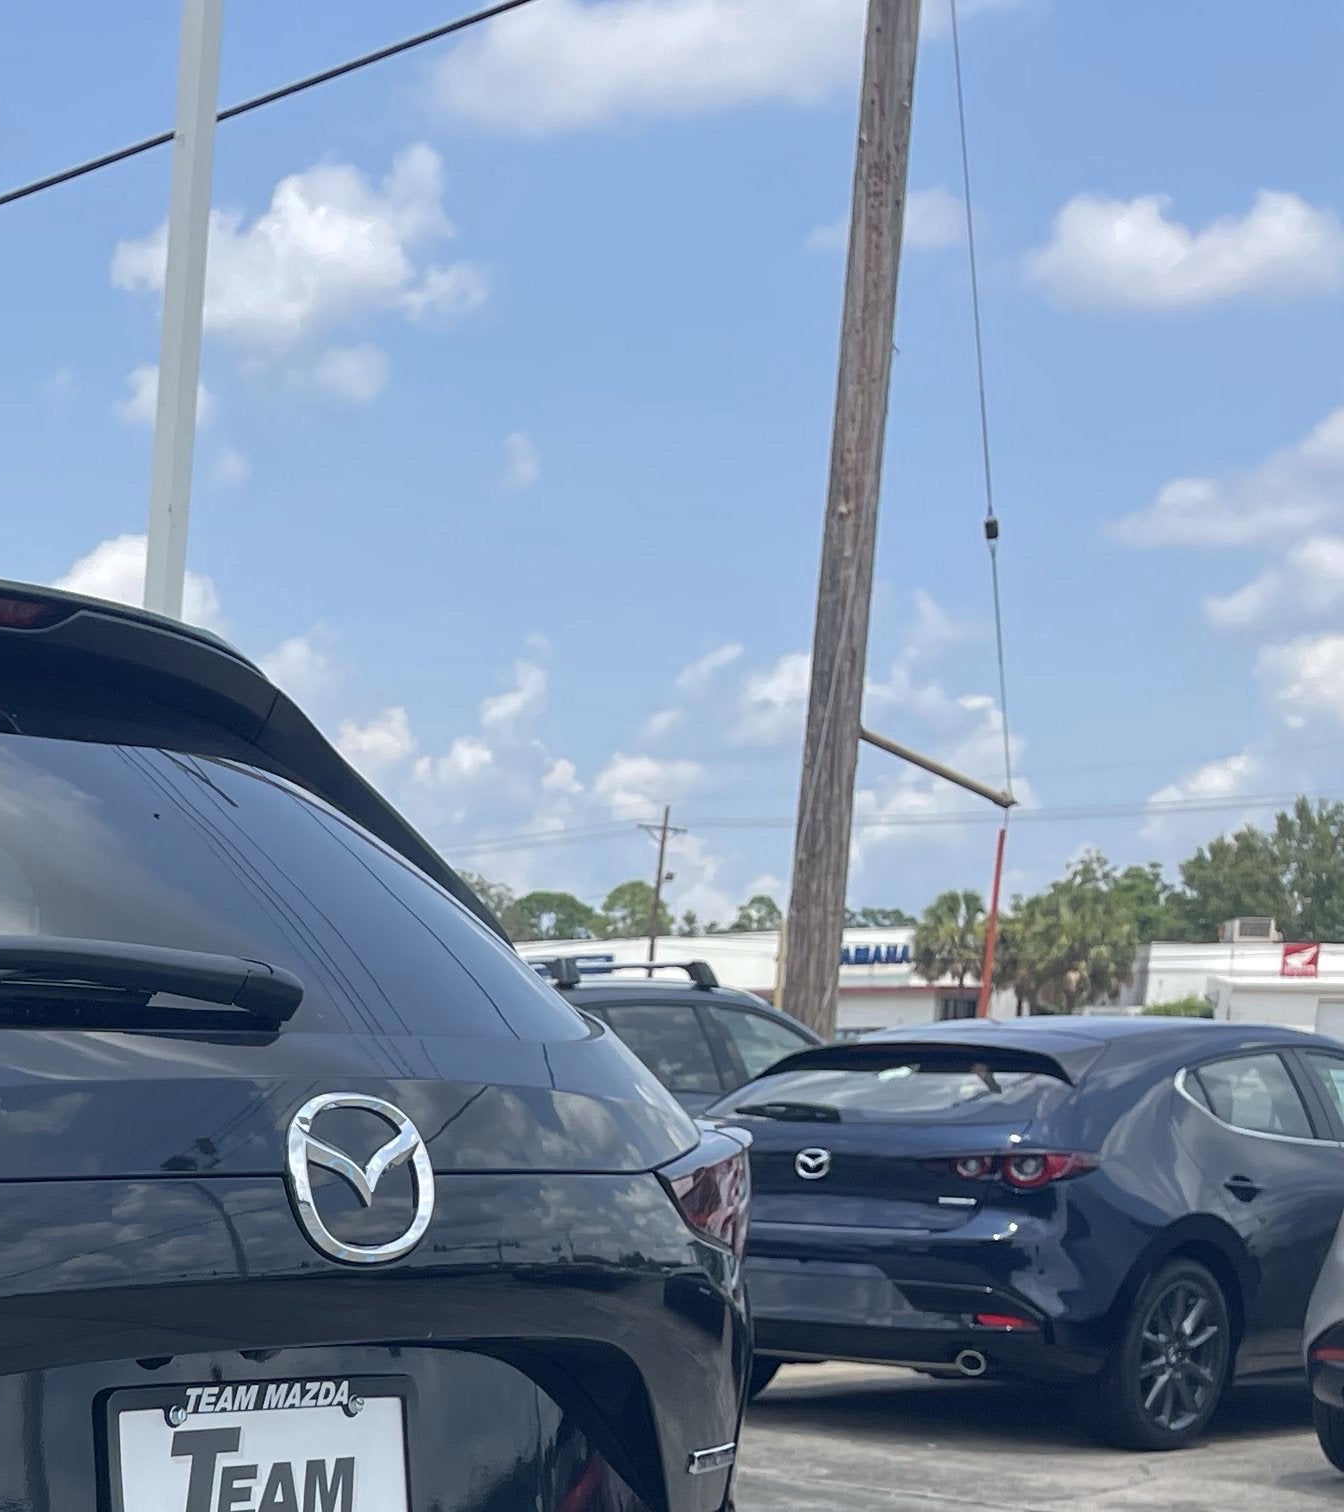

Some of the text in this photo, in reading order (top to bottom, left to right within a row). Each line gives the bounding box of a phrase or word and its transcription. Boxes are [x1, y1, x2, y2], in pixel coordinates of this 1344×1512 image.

[840, 944, 910, 964] AMAHA
[185, 1380, 350, 1413] TEAM MAZDA
